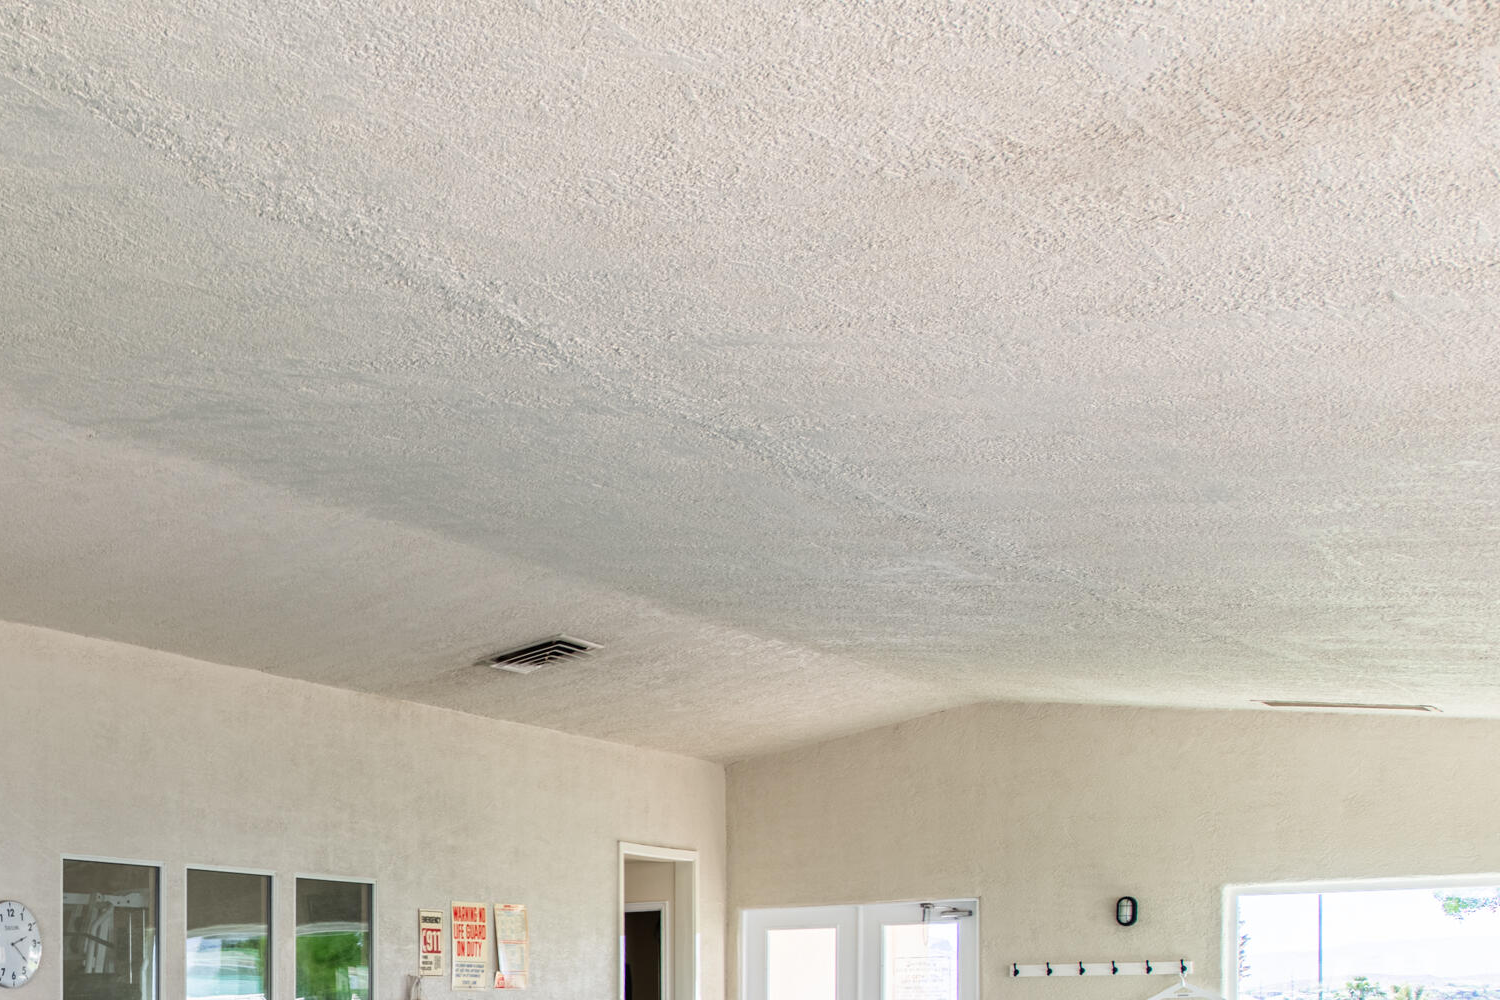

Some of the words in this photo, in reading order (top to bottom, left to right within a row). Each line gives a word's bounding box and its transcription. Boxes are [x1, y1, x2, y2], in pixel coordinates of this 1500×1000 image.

[7, 909, 15, 917] 12
[453, 906, 477, 922] WARNING
[479, 907, 486, 923] NO
[28, 923, 32, 931] 2
[454, 924, 464, 939] LIFE
[466, 924, 486, 940] GUARD
[457, 941, 465, 957] ON
[467, 941, 482, 957] DUTY
[1, 968, 5, 976] 7
[22, 966, 26, 974] 5
[12, 972, 16, 980] 6
